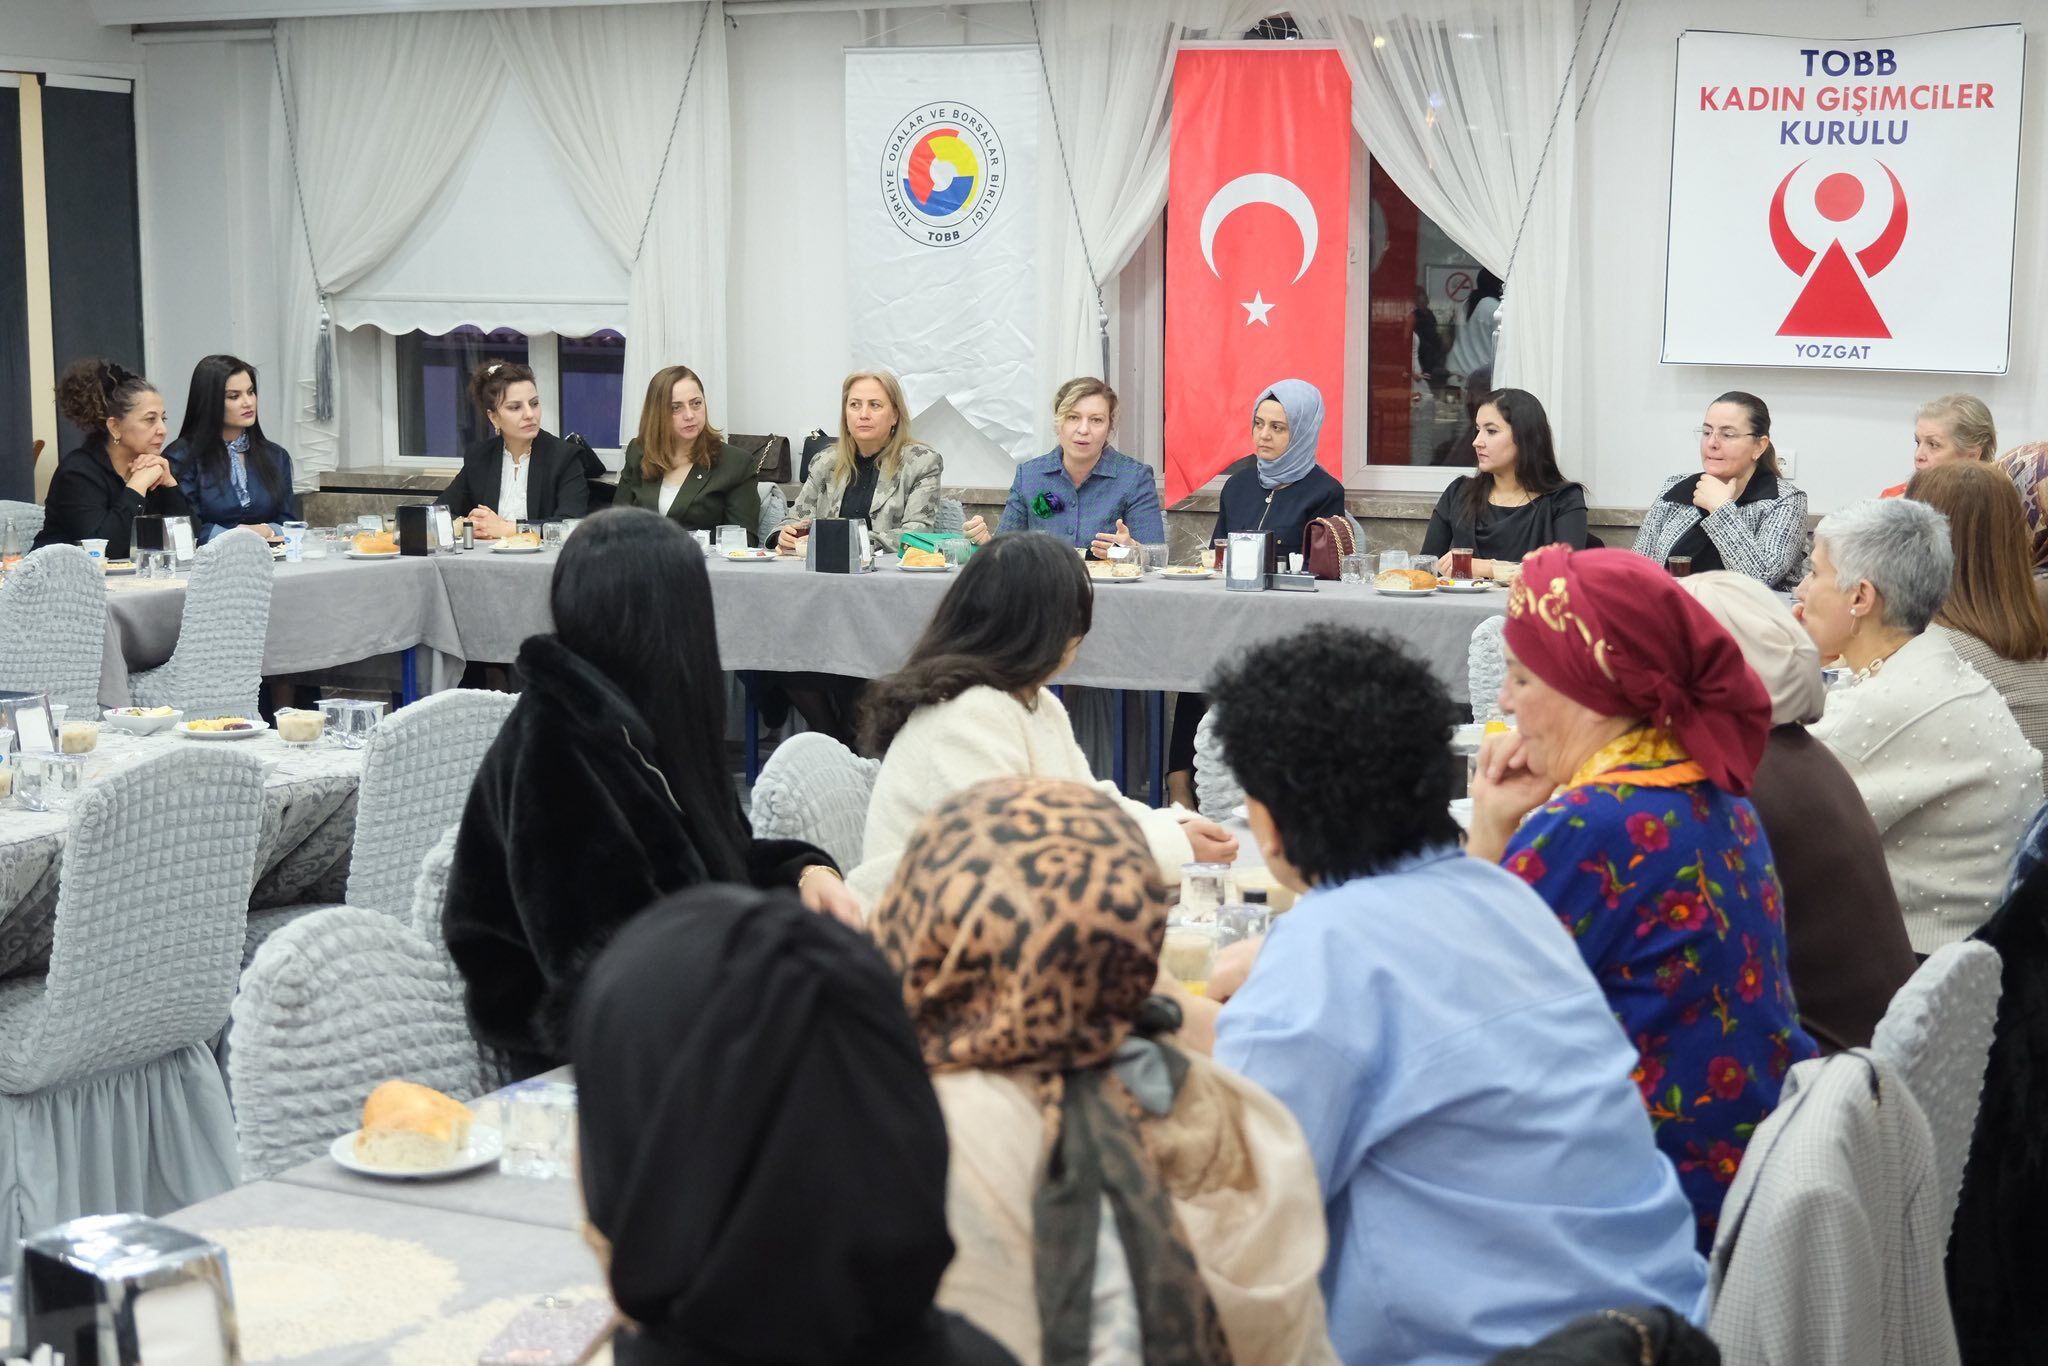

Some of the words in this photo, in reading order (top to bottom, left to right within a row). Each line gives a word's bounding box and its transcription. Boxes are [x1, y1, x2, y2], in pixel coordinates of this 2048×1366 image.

[1800, 48, 1898, 77] TOBB
[1700, 86, 1806, 112] KADIN
[930, 108, 945, 119] VE
[889, 115, 924, 161] ODALAR
[952, 109, 999, 166] BORSALAR
[1780, 120, 1909, 145] KURULU
[887, 170, 912, 227] TÜRKİYE
[928, 230, 961, 242] TOBB
[1795, 343, 1871, 360] YOZGAT
